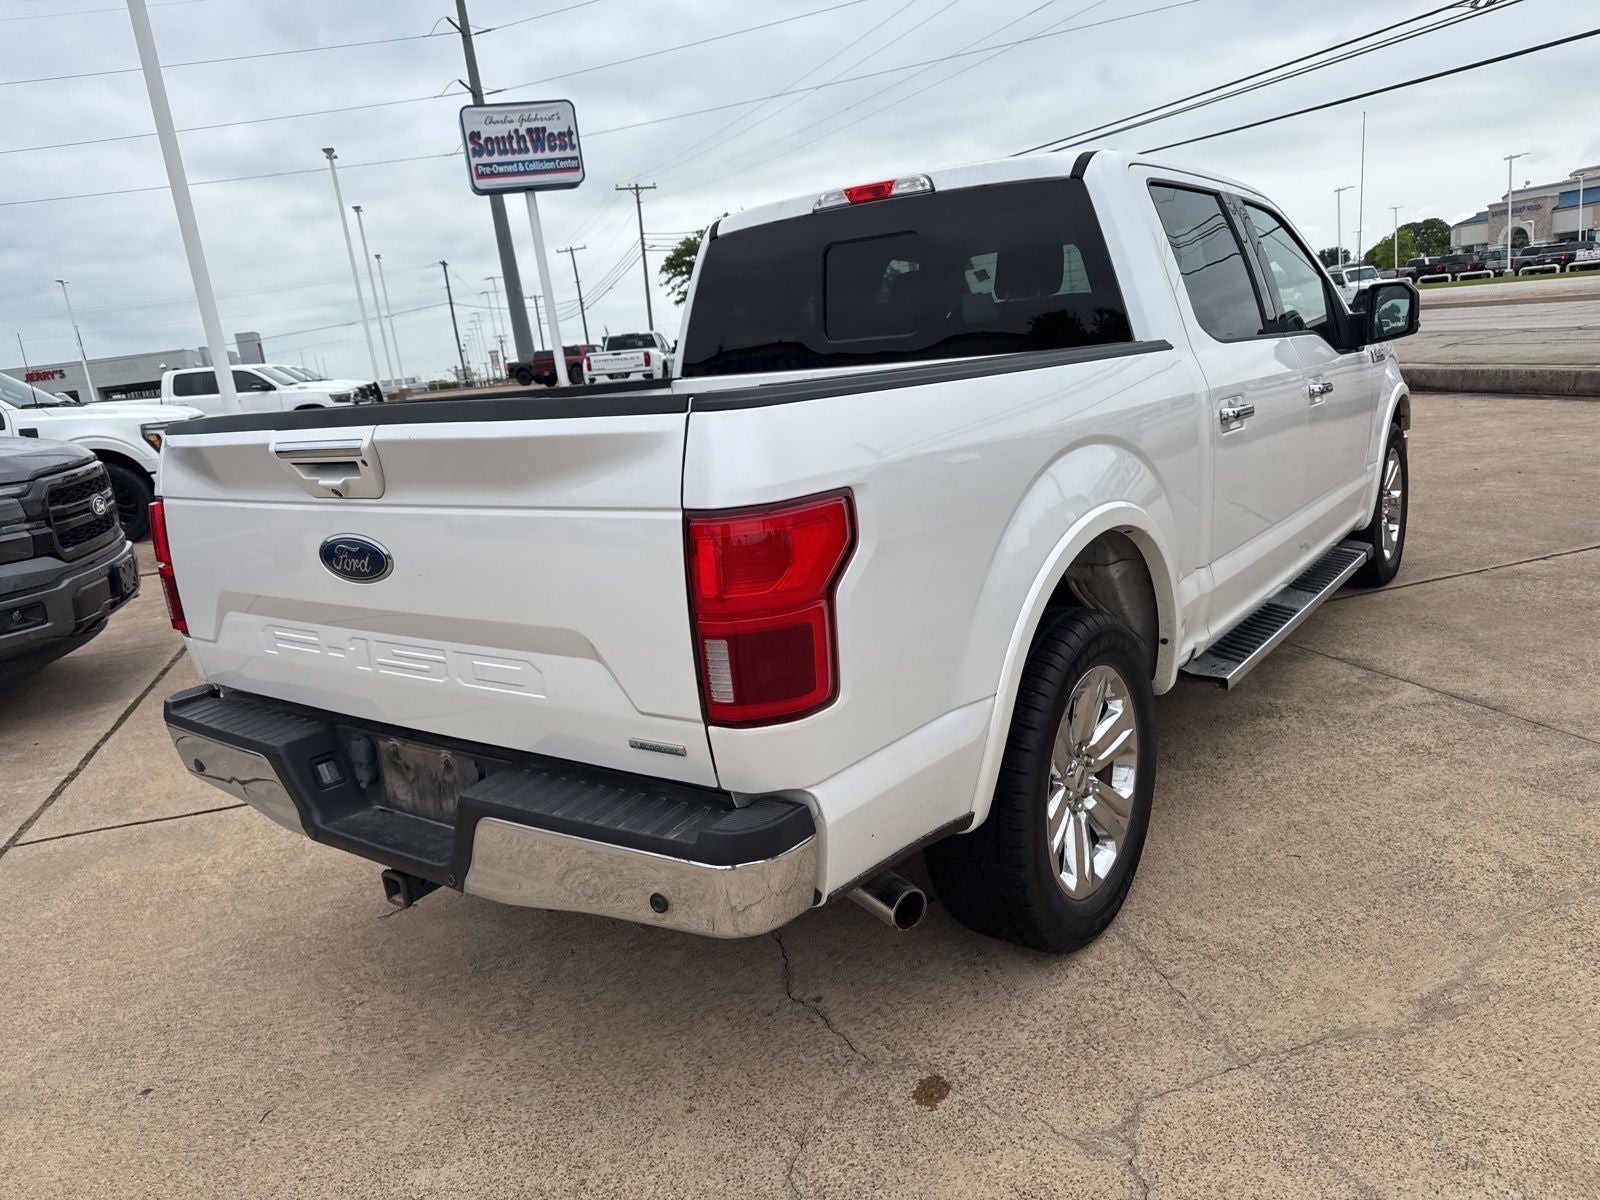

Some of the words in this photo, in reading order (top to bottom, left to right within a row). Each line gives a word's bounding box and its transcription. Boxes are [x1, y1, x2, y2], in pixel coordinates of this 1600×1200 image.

[484, 115, 514, 126] Charlie
[468, 125, 576, 159] SouthWest
[477, 163, 518, 175] Pre-Owned
[518, 162, 525, 171] &
[524, 160, 555, 171] Collision
[555, 158, 579, 169] Center
[594, 356, 640, 364] CHEVROLET
[25, 369, 66, 382] JERRY'S
[333, 544, 372, 573] Ford
[262, 624, 546, 699] F-150
